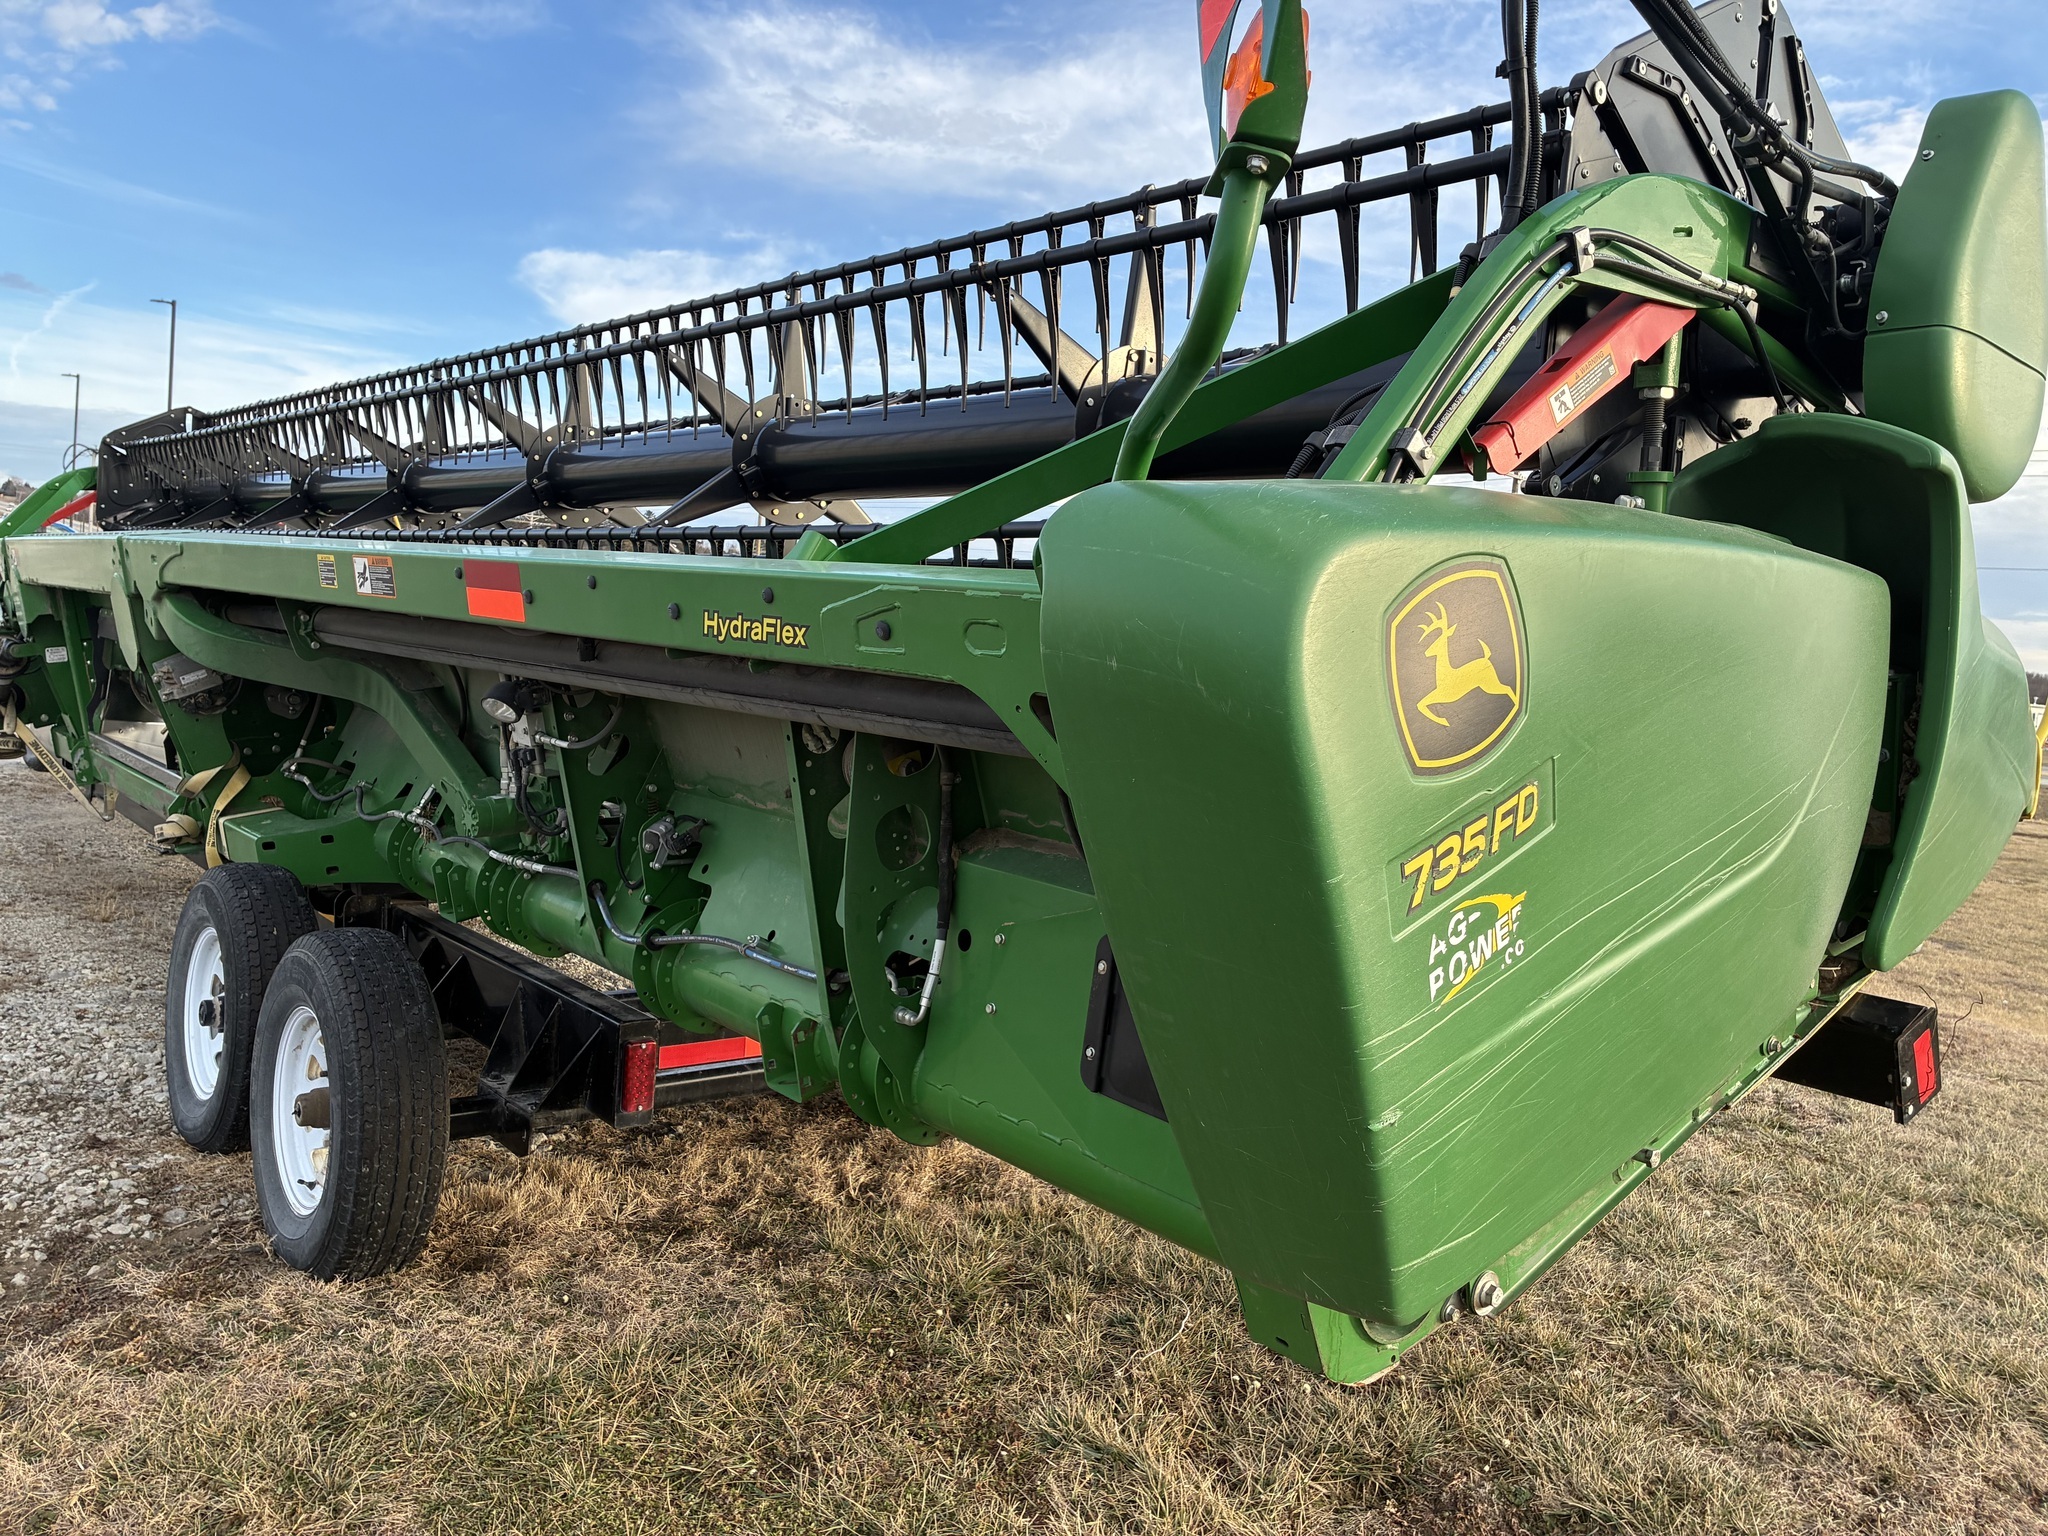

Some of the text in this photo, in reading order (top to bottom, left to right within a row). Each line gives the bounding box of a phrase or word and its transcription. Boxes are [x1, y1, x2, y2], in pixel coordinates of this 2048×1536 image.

[1580, 350, 1604, 375] WARNING
[703, 610, 809, 648] HydraFlex
[29, 739, 62, 777] KINEDYNE
[1401, 781, 1539, 916] 735FD
